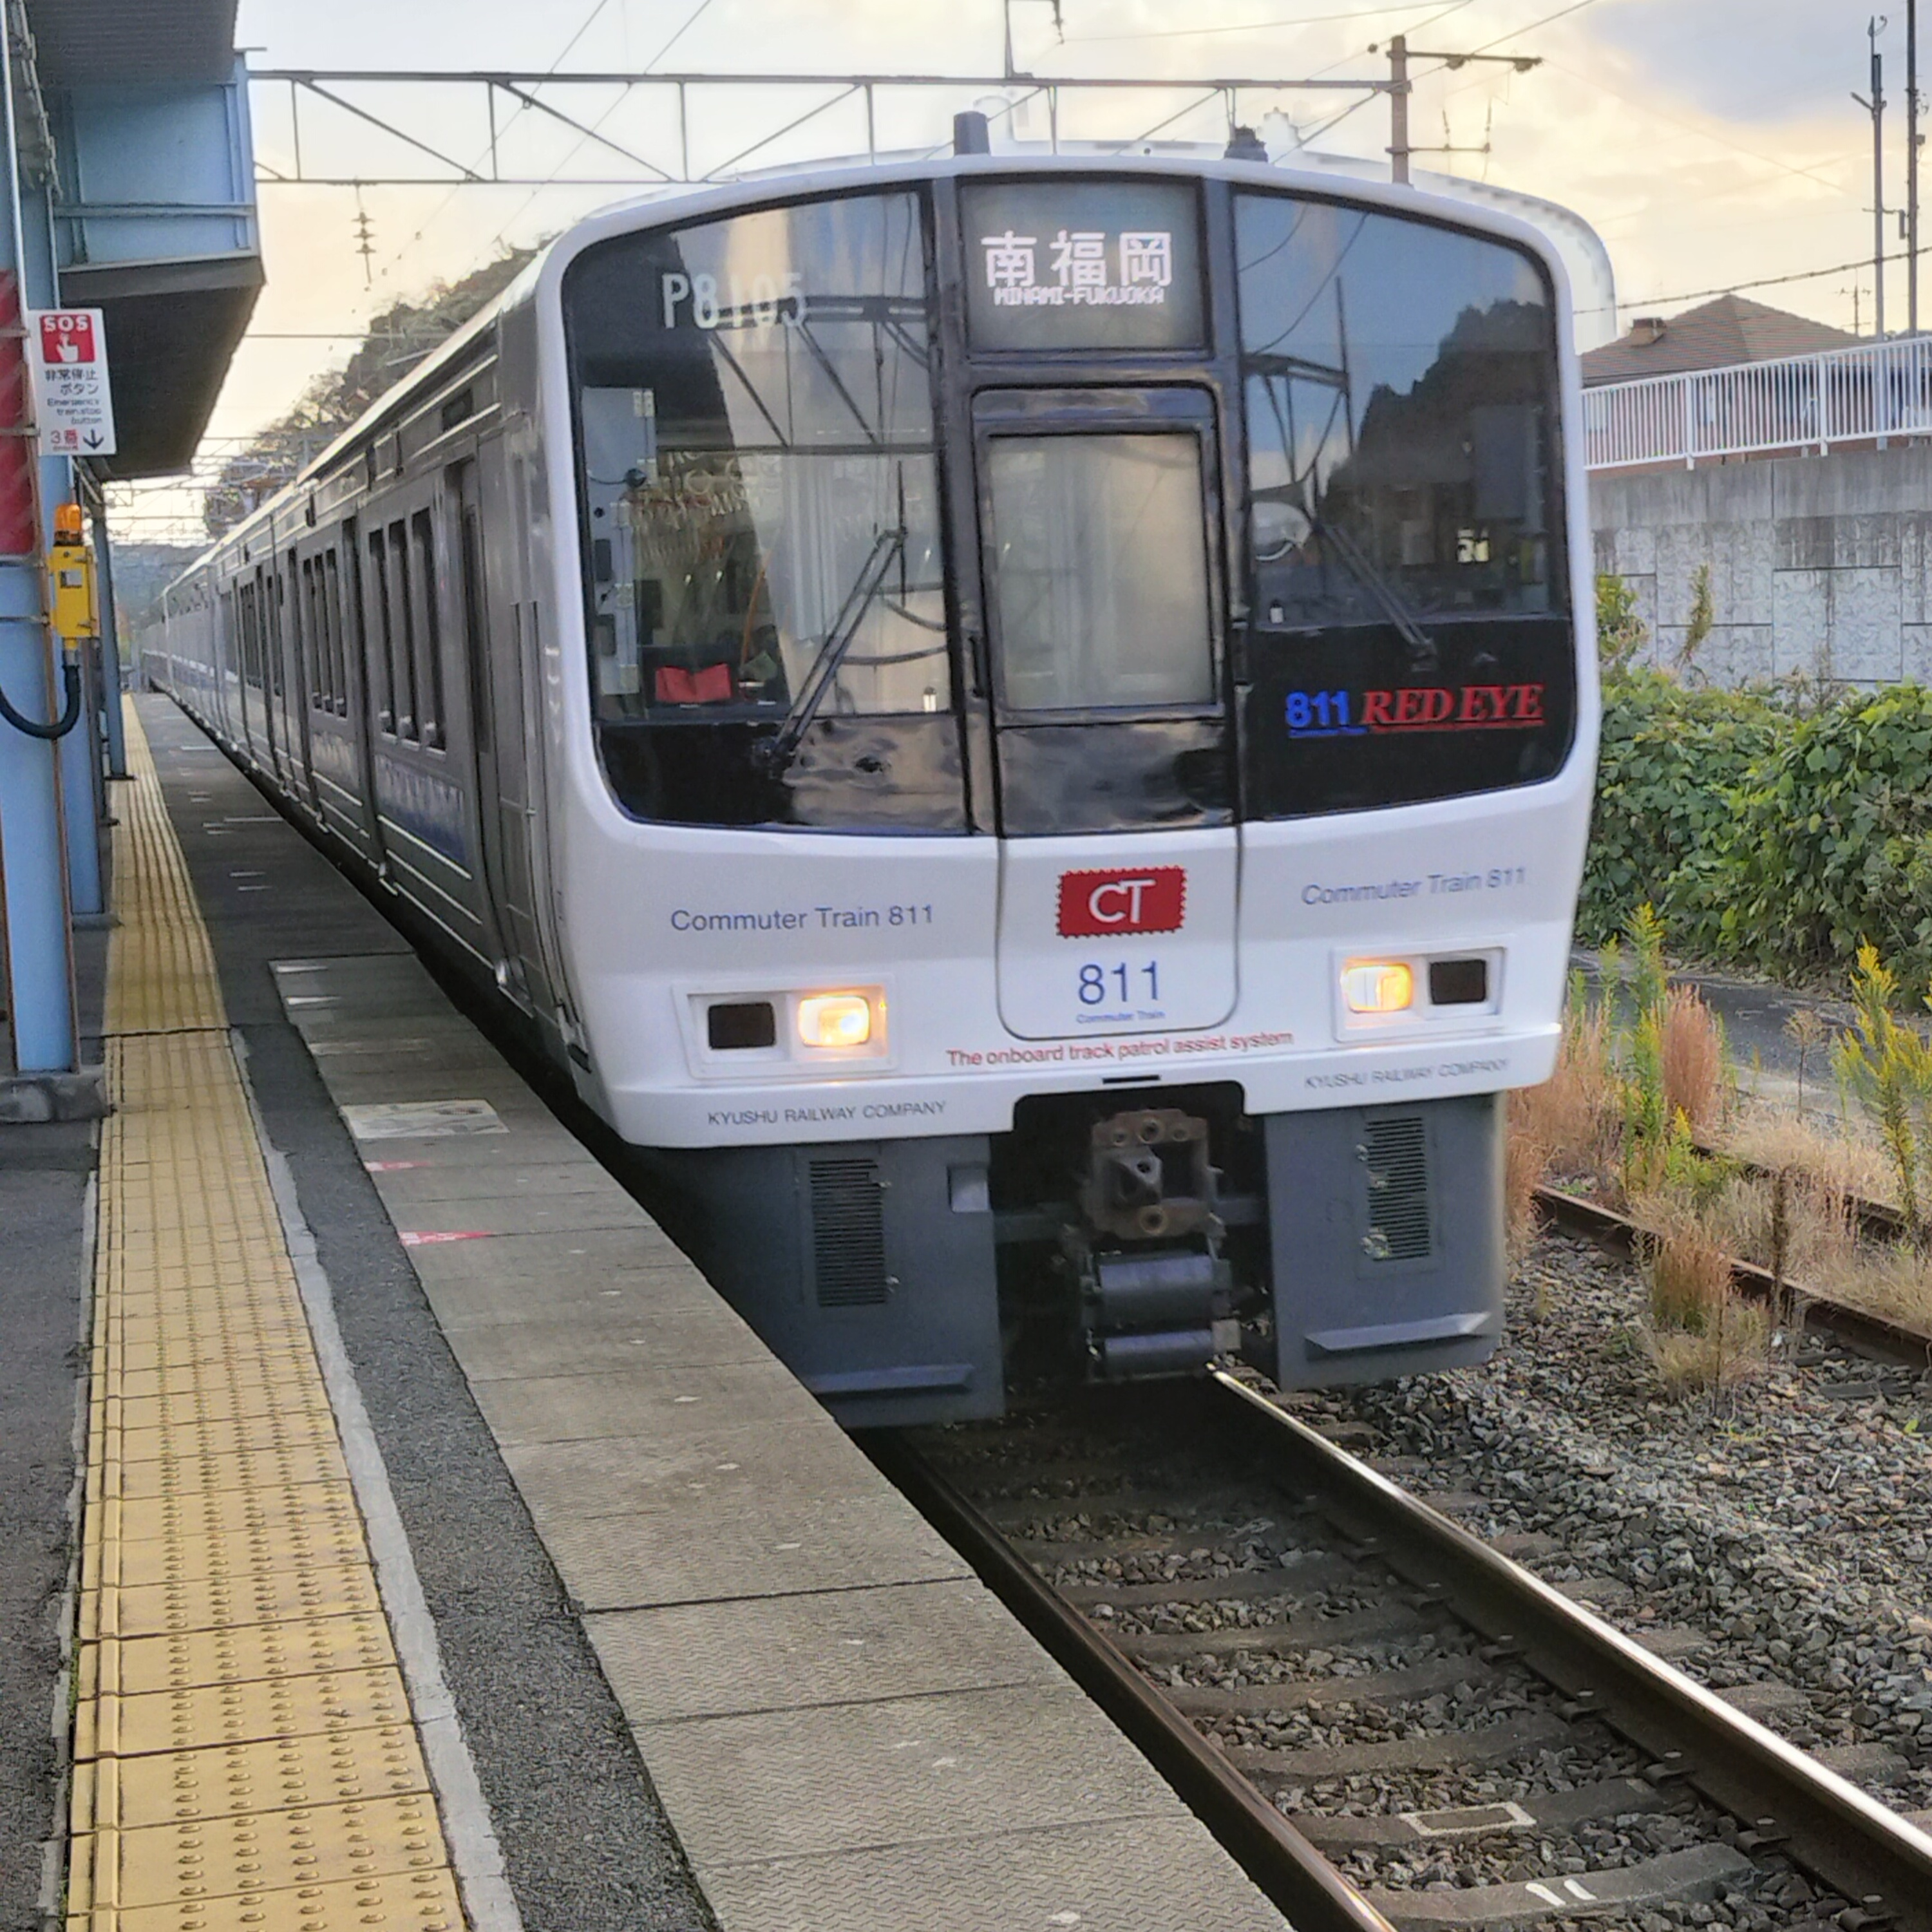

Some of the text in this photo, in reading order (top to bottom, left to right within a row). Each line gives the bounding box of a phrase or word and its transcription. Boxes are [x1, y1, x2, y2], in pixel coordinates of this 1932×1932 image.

[980, 230, 1173, 287] 南福岡
[661, 272, 806, 329] P8105
[994, 287, 1164, 306] MINAMI-FUKUOKA
[44, 316, 89, 332] SOS
[44, 368, 99, 381] 非常停止
[60, 383, 99, 395] ボタン
[1285, 690, 1349, 728] 811
[1359, 688, 1455, 724] RED
[1455, 683, 1544, 721] EYE
[1088, 878, 1157, 924] CT
[1302, 866, 1526, 905] Commuter Train 811
[671, 904, 934, 931] Commuter Train 811
[1078, 960, 1159, 1005] 811
[947, 1032, 1294, 1066] The onboard track patrol assist system
[708, 1100, 947, 1126] KYUSHU RAILWAY COMPANY
